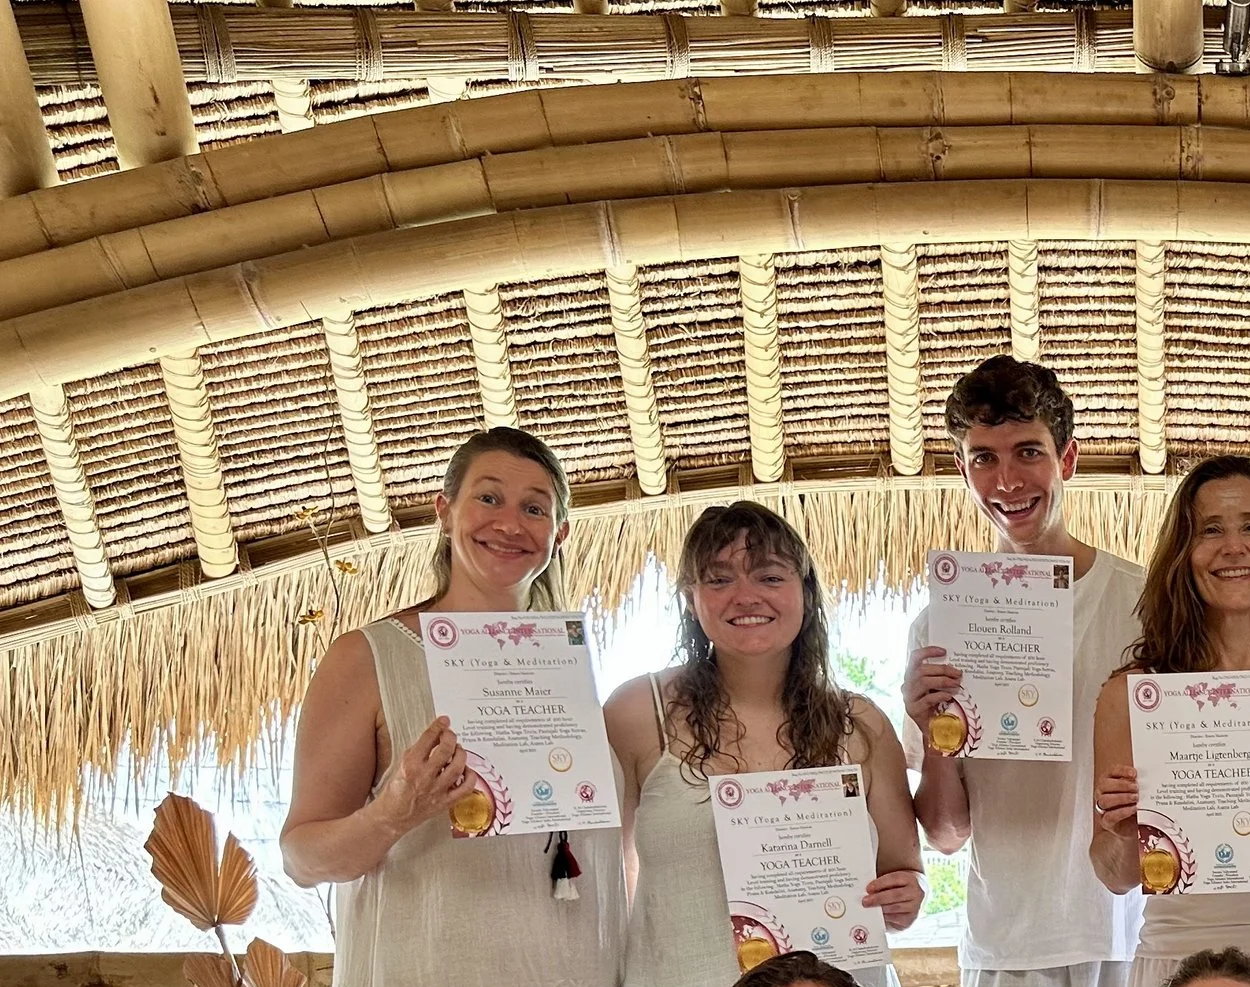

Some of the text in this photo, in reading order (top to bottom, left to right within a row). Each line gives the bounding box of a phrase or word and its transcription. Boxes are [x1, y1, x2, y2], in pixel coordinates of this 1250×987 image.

[965, 595, 989, 604] (Yoga
[1006, 598, 1059, 608] Meditation)
[969, 624, 1032, 635] Elouen Rolland
[964, 641, 1040, 653] YOGA TEACHER
[482, 687, 551, 697] Susanne Maier
[478, 705, 566, 716] YOGA TEACHER
[1170, 722, 1196, 730] (Yoga
[1170, 751, 1203, 762] Maartje
[1172, 770, 1202, 780] YOGA
[730, 817, 750, 826] SKY
[754, 815, 780, 825] (Yoga
[796, 810, 852, 820] Meditation)
[761, 838, 832, 853] Katarina Darnell
[760, 856, 840, 870] YOGA TEACHER
